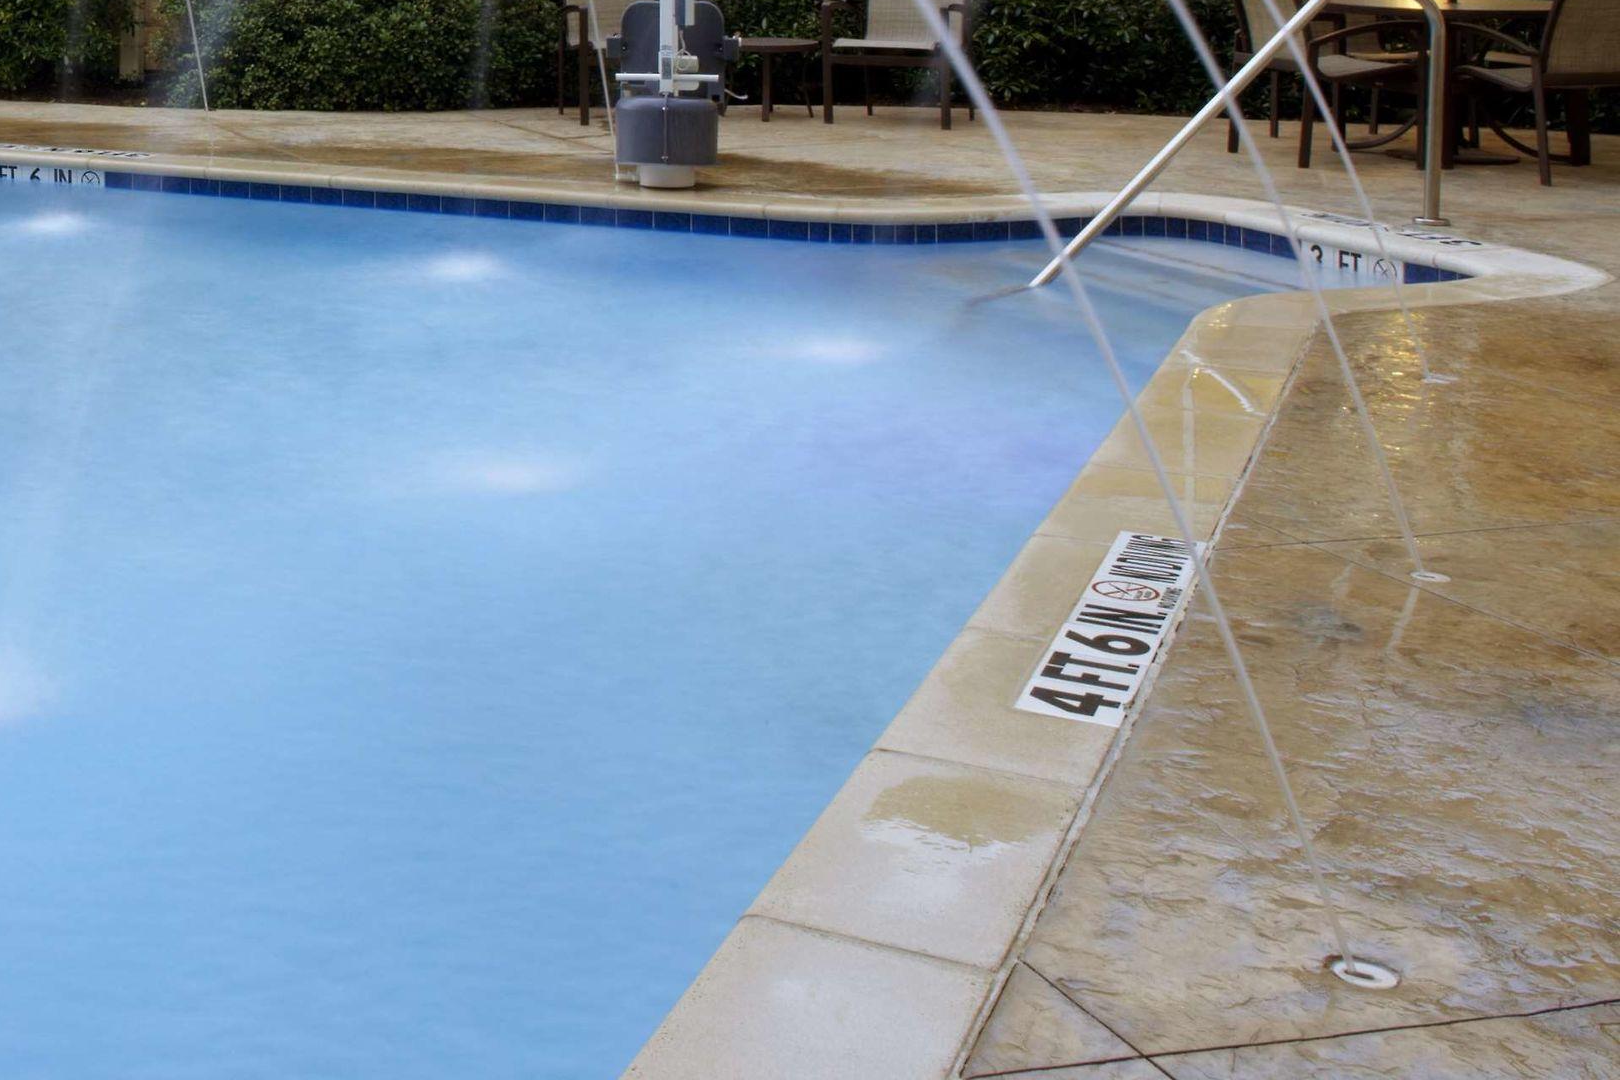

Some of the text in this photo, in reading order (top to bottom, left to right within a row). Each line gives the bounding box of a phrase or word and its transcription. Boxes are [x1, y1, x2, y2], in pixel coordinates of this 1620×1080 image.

[54, 168, 72, 184] IN
[1339, 249, 1361, 272] FT
[1107, 564, 1181, 585] NO
[1065, 629, 1151, 656] 6
[1029, 686, 1121, 717] 4
